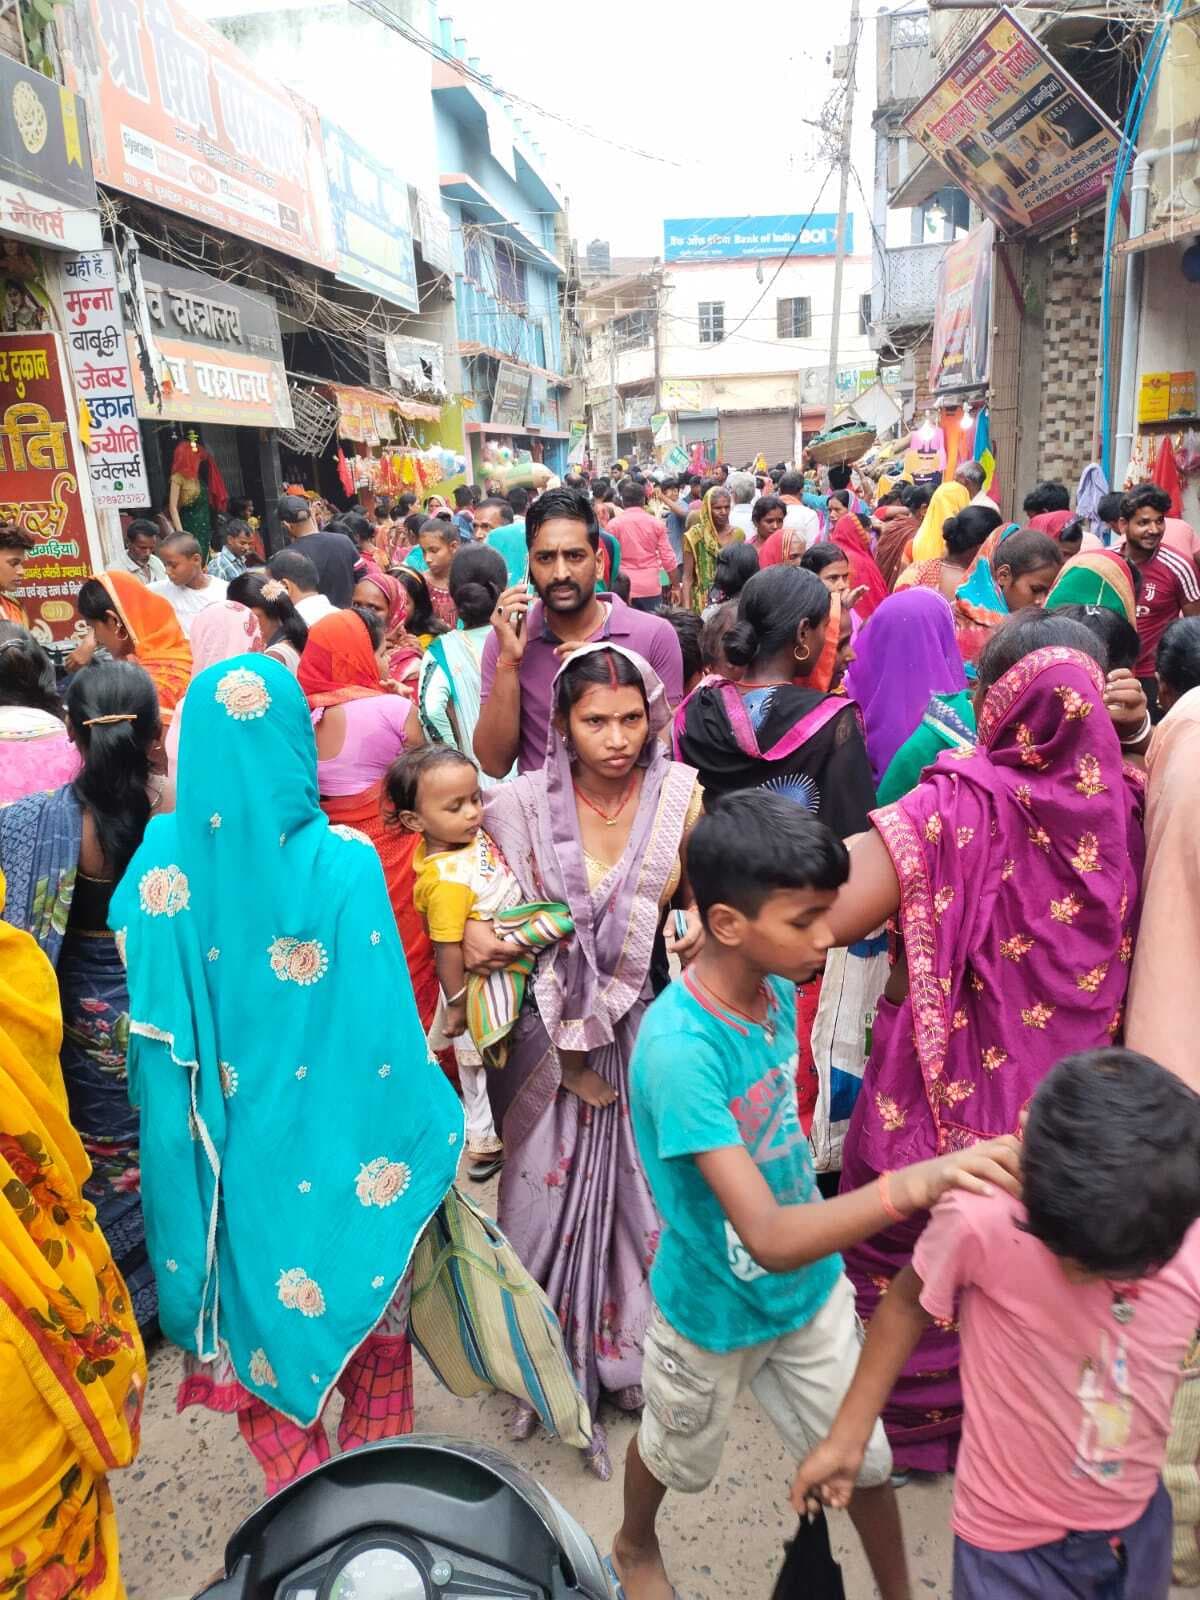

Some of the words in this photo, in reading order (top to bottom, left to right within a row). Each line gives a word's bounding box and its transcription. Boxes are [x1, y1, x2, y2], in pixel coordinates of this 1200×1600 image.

[799, 228, 826, 244] BOI
[63, 288, 114, 326] मुन्ना
[9, 349, 50, 399] दुकान
[75, 362, 127, 390] जेबर
[86, 395, 135, 429] दुकान
[89, 425, 139, 454] ज्योति
[90, 454, 141, 480] ज्वेलर्स
